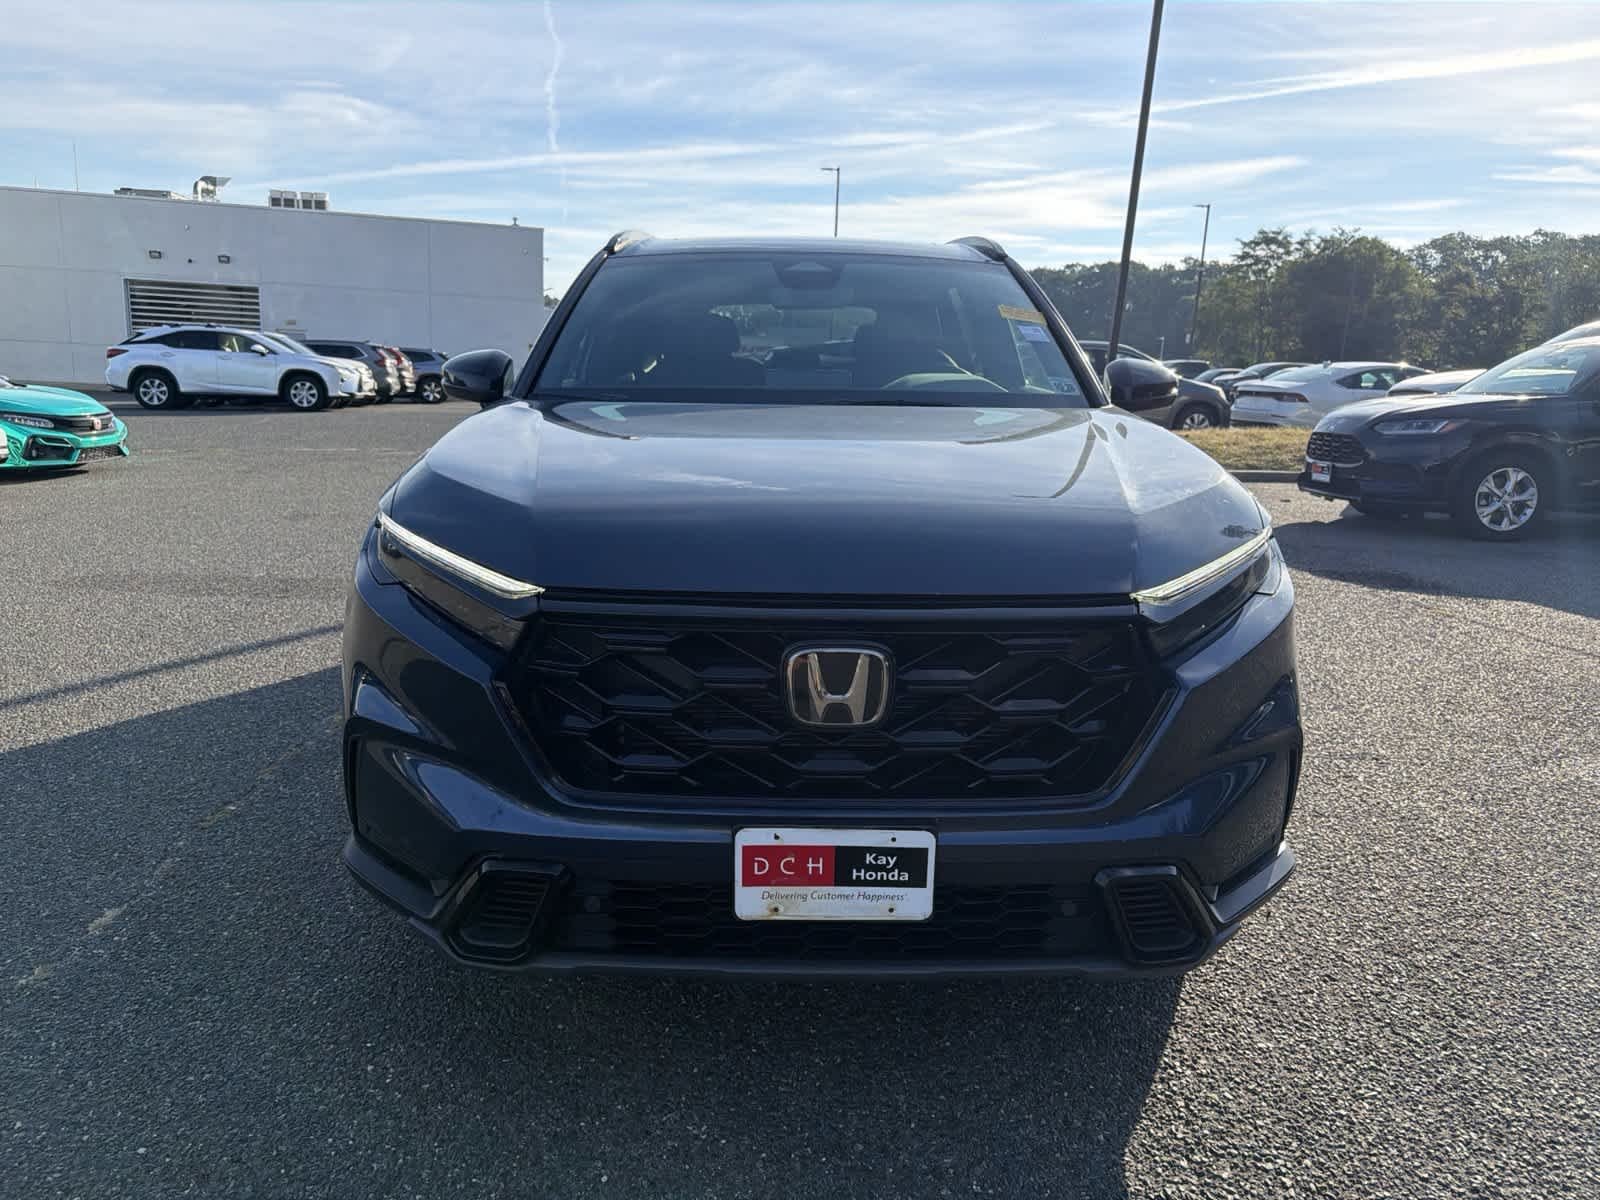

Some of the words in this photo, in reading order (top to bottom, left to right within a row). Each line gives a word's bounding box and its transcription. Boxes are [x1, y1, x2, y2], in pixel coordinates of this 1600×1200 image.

[865, 853, 897, 868] Kay
[852, 868, 909, 881] Honda
[761, 890, 808, 902] Delivering
[810, 891, 855, 900] Customer
[857, 892, 905, 902] Happiness
